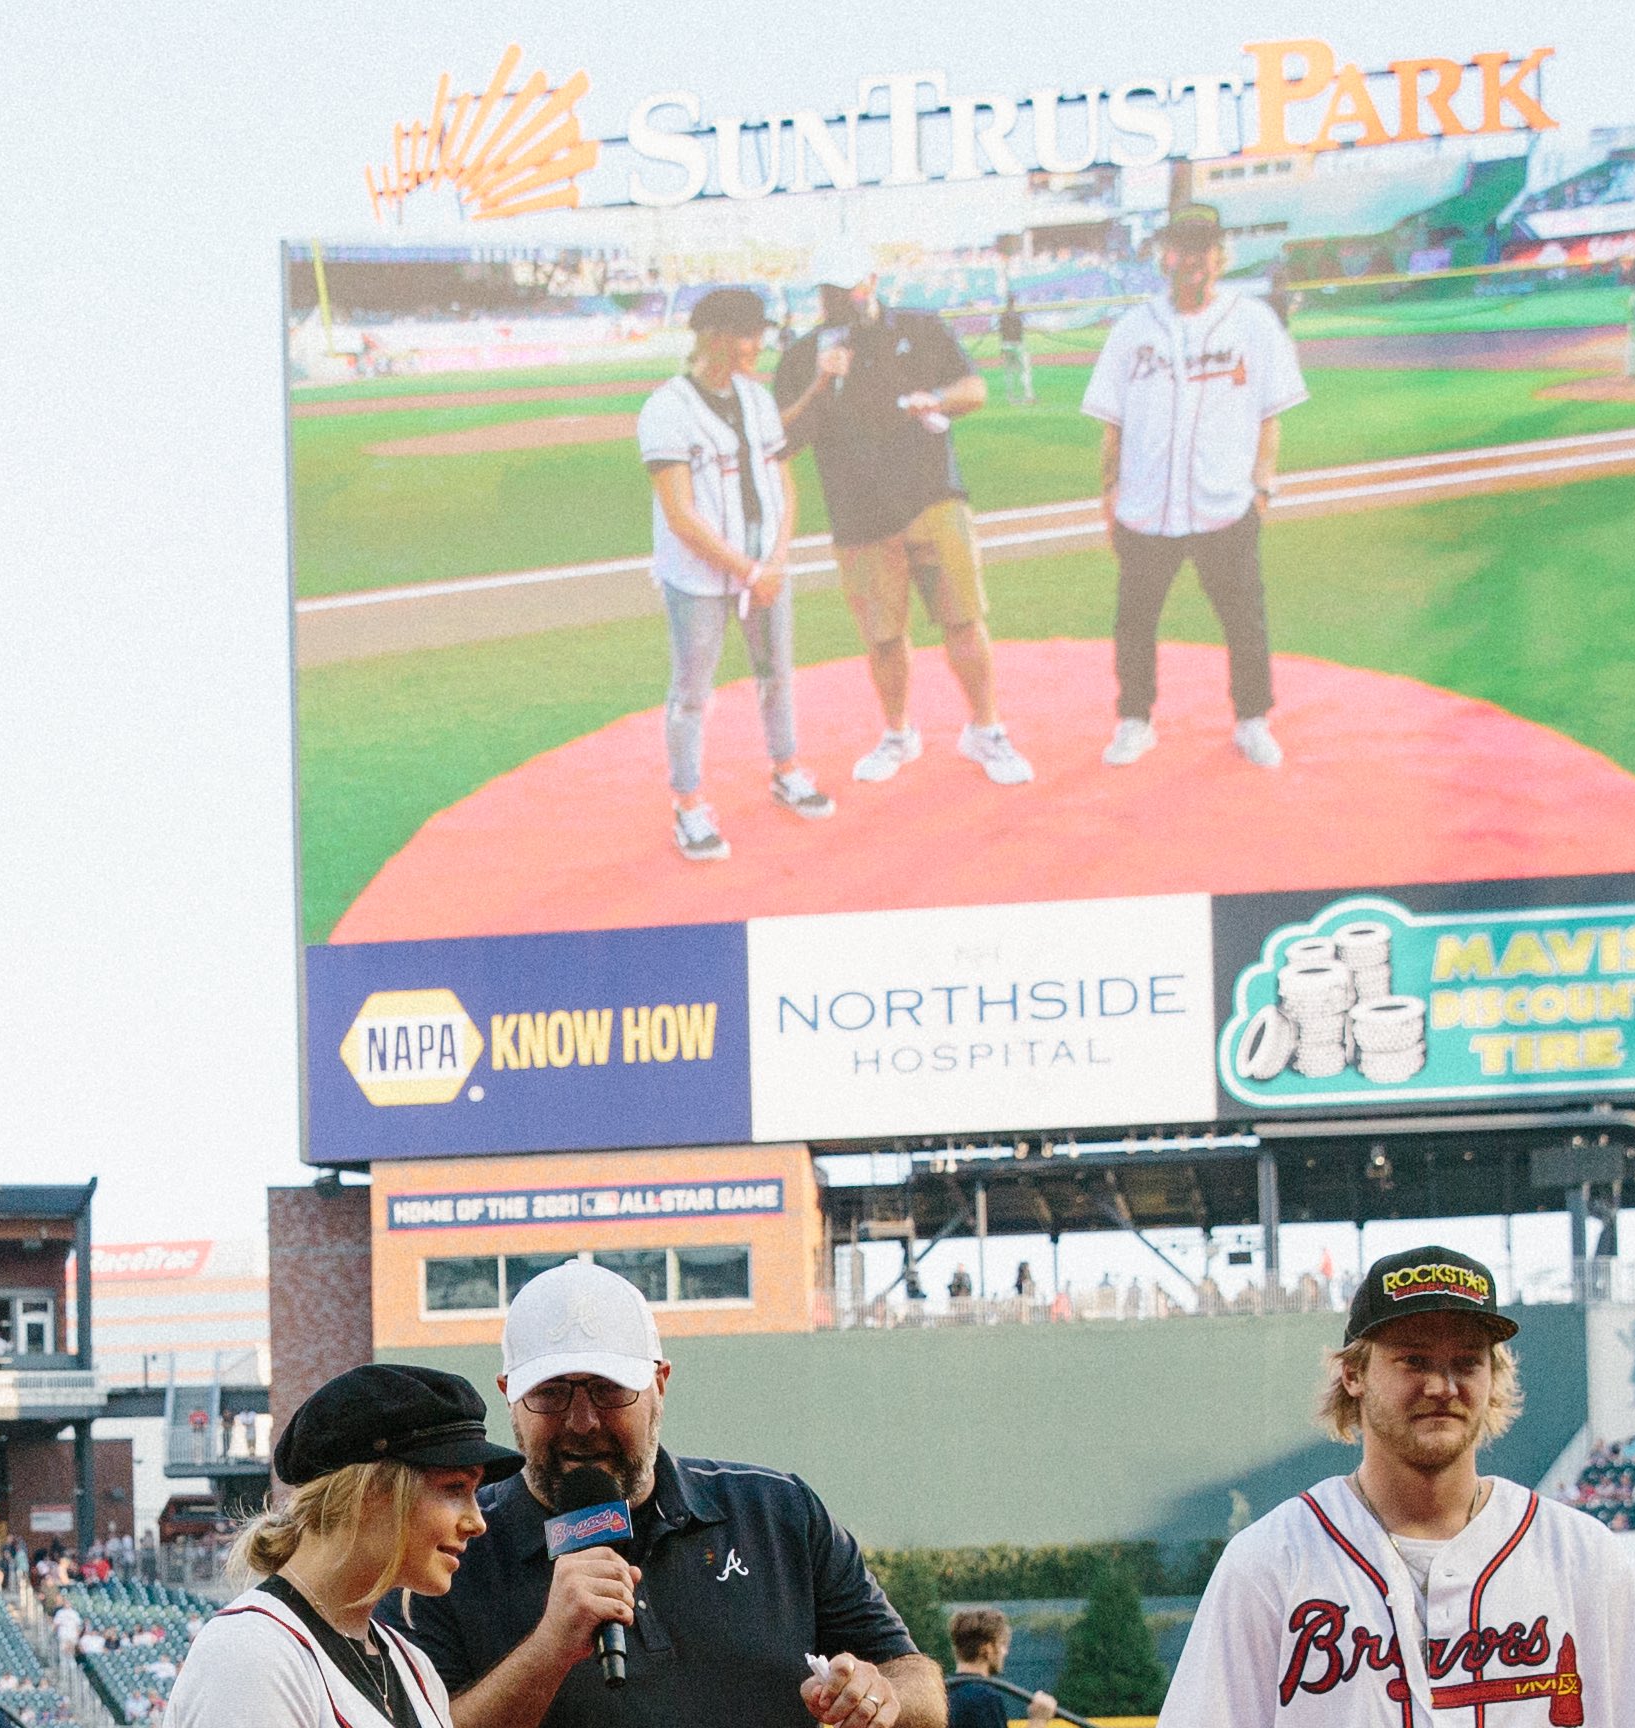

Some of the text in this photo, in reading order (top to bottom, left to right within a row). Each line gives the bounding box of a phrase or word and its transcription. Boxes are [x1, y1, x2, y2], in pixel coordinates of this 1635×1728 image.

[778, 974, 1187, 1034] NORTHSIDE
[365, 1022, 458, 1074] NAPA
[490, 1002, 718, 1071] KNOW HOW
[852, 1038, 1112, 1075] HOSPITAL
[1471, 1029, 1627, 1074] TIRE
[393, 1199, 455, 1224] HOME
[455, 1198, 483, 1222] OF
[484, 1196, 528, 1220] THE
[716, 1185, 779, 1209] GAME
[551, 1509, 611, 1549] Braves
[716, 1548, 749, 1582] A
